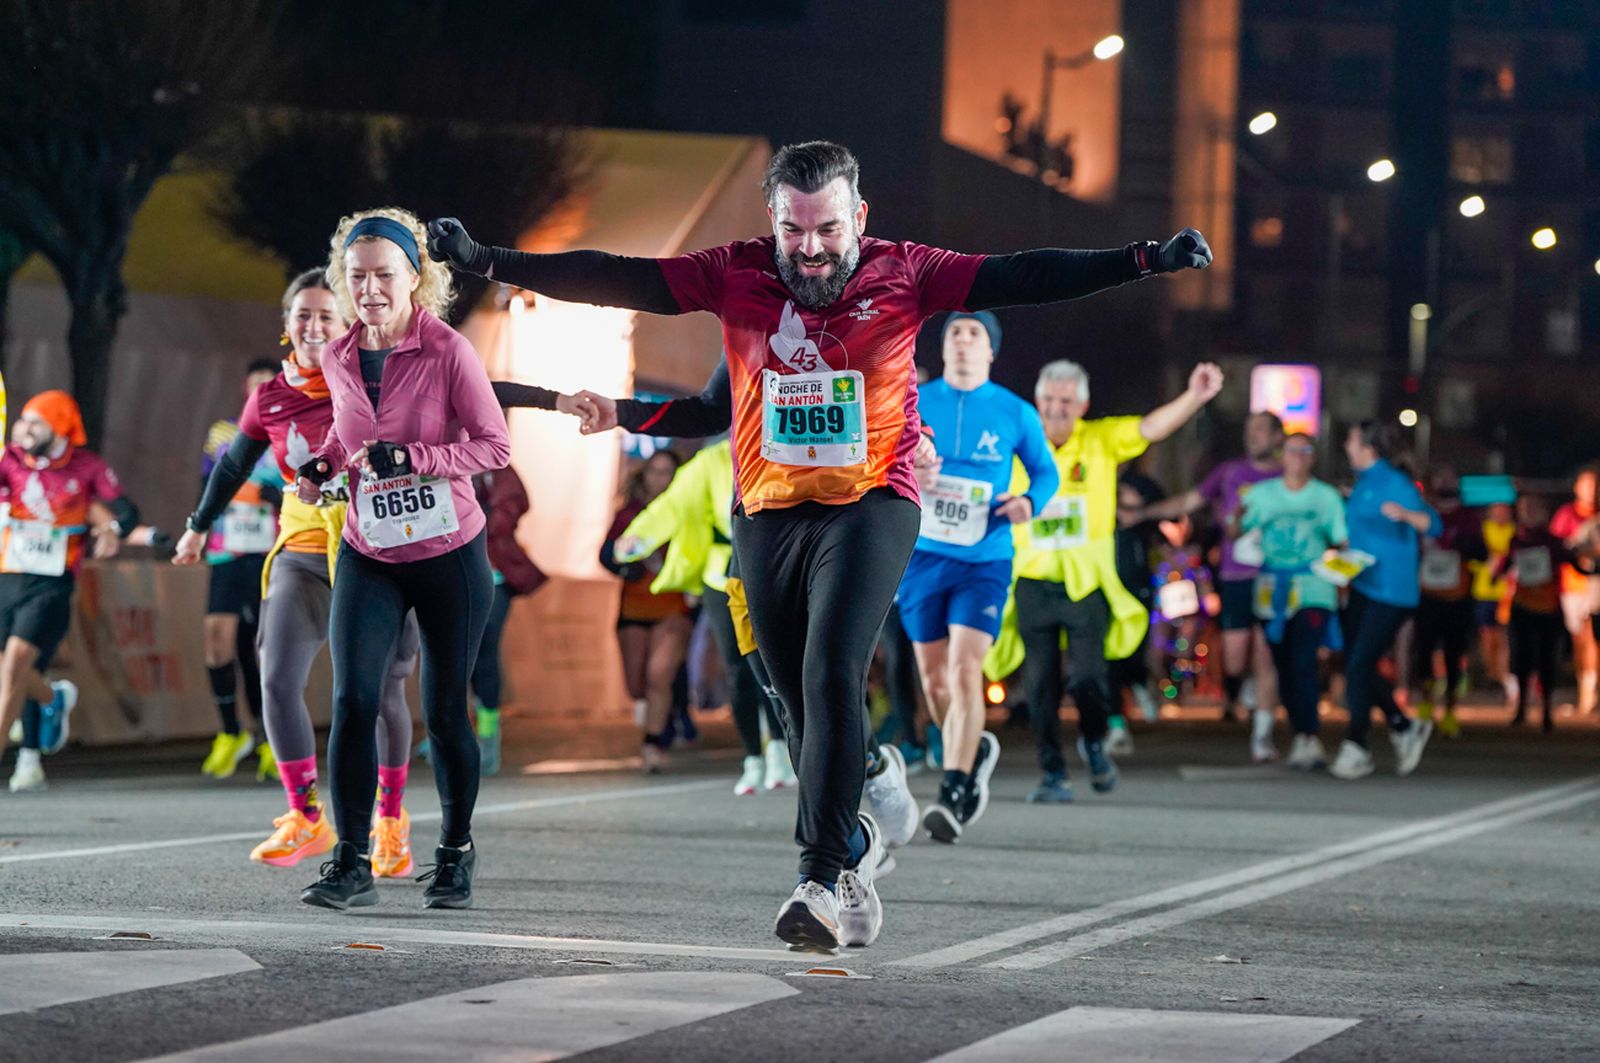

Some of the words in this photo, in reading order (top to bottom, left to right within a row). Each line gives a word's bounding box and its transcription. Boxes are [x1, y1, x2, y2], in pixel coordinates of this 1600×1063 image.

[789, 346, 817, 372] 43
[810, 383, 823, 393] DE
[775, 405, 845, 435] 7969
[363, 483, 380, 495] SAN
[372, 485, 436, 519] 6656
[934, 499, 968, 521] 806
